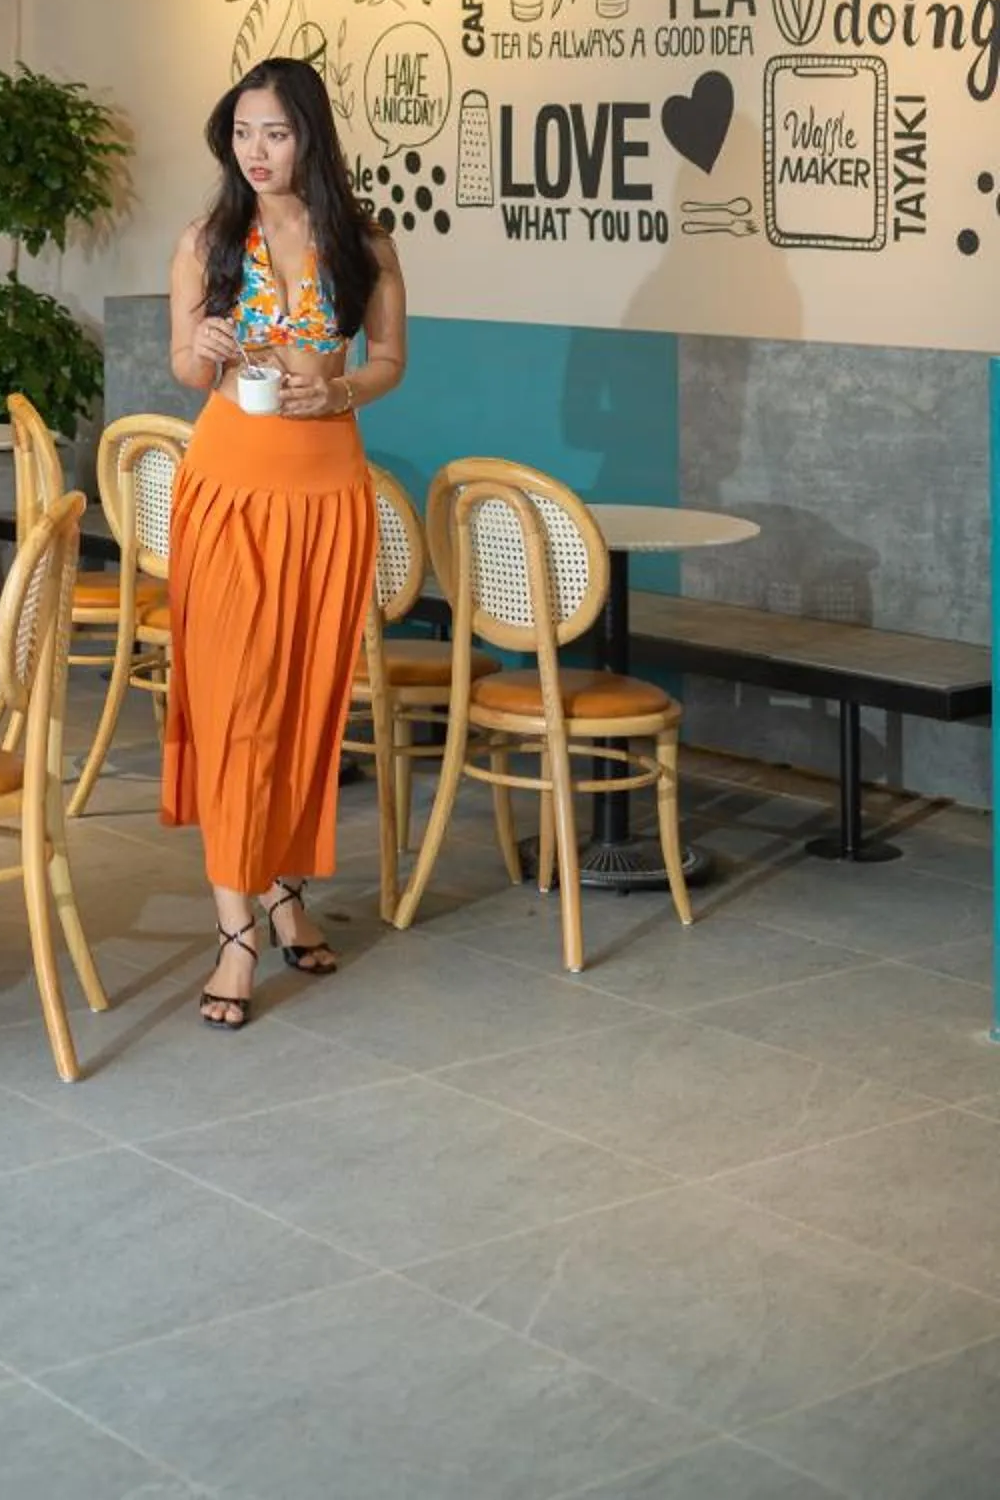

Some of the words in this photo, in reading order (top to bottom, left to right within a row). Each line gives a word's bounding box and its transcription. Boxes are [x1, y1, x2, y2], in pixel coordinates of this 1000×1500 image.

[490, 33, 520, 59] TEA
[527, 32, 544, 58] IS
[550, 29, 626, 58] ALWAYS
[630, 29, 647, 58] A
[654, 27, 705, 57] GOOD
[710, 25, 755, 56] IDEA
[384, 53, 429, 97] HAVE
[500, 102, 654, 201] LOVE
[783, 106, 858, 156] Waffle
[778, 155, 871, 189] MAKER
[893, 95, 927, 241] TAYAKI
[501, 203, 572, 242] WHAT
[578, 208, 631, 242] YOU
[639, 208, 669, 243] DO
